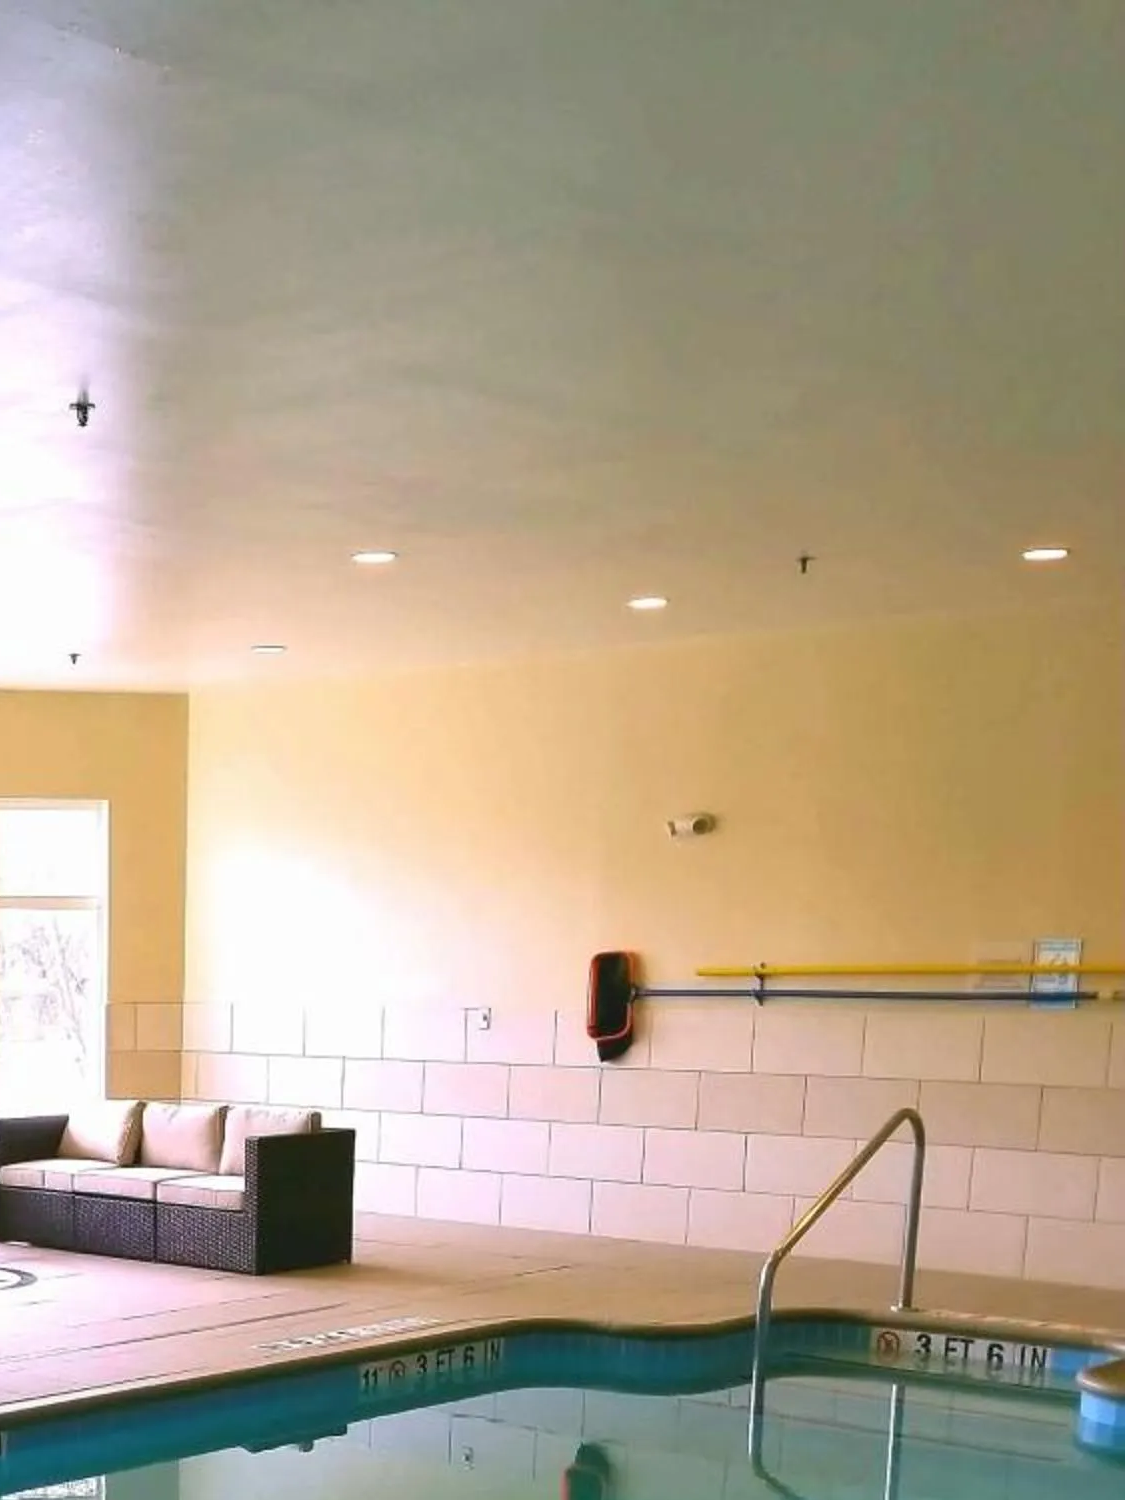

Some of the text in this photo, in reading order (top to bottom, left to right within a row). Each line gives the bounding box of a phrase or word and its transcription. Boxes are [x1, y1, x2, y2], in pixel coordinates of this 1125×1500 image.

[436, 1347, 455, 1370] FT
[945, 1336, 974, 1360] FT
[987, 1343, 1004, 1370] 6
[1020, 1345, 1047, 1368] IN
